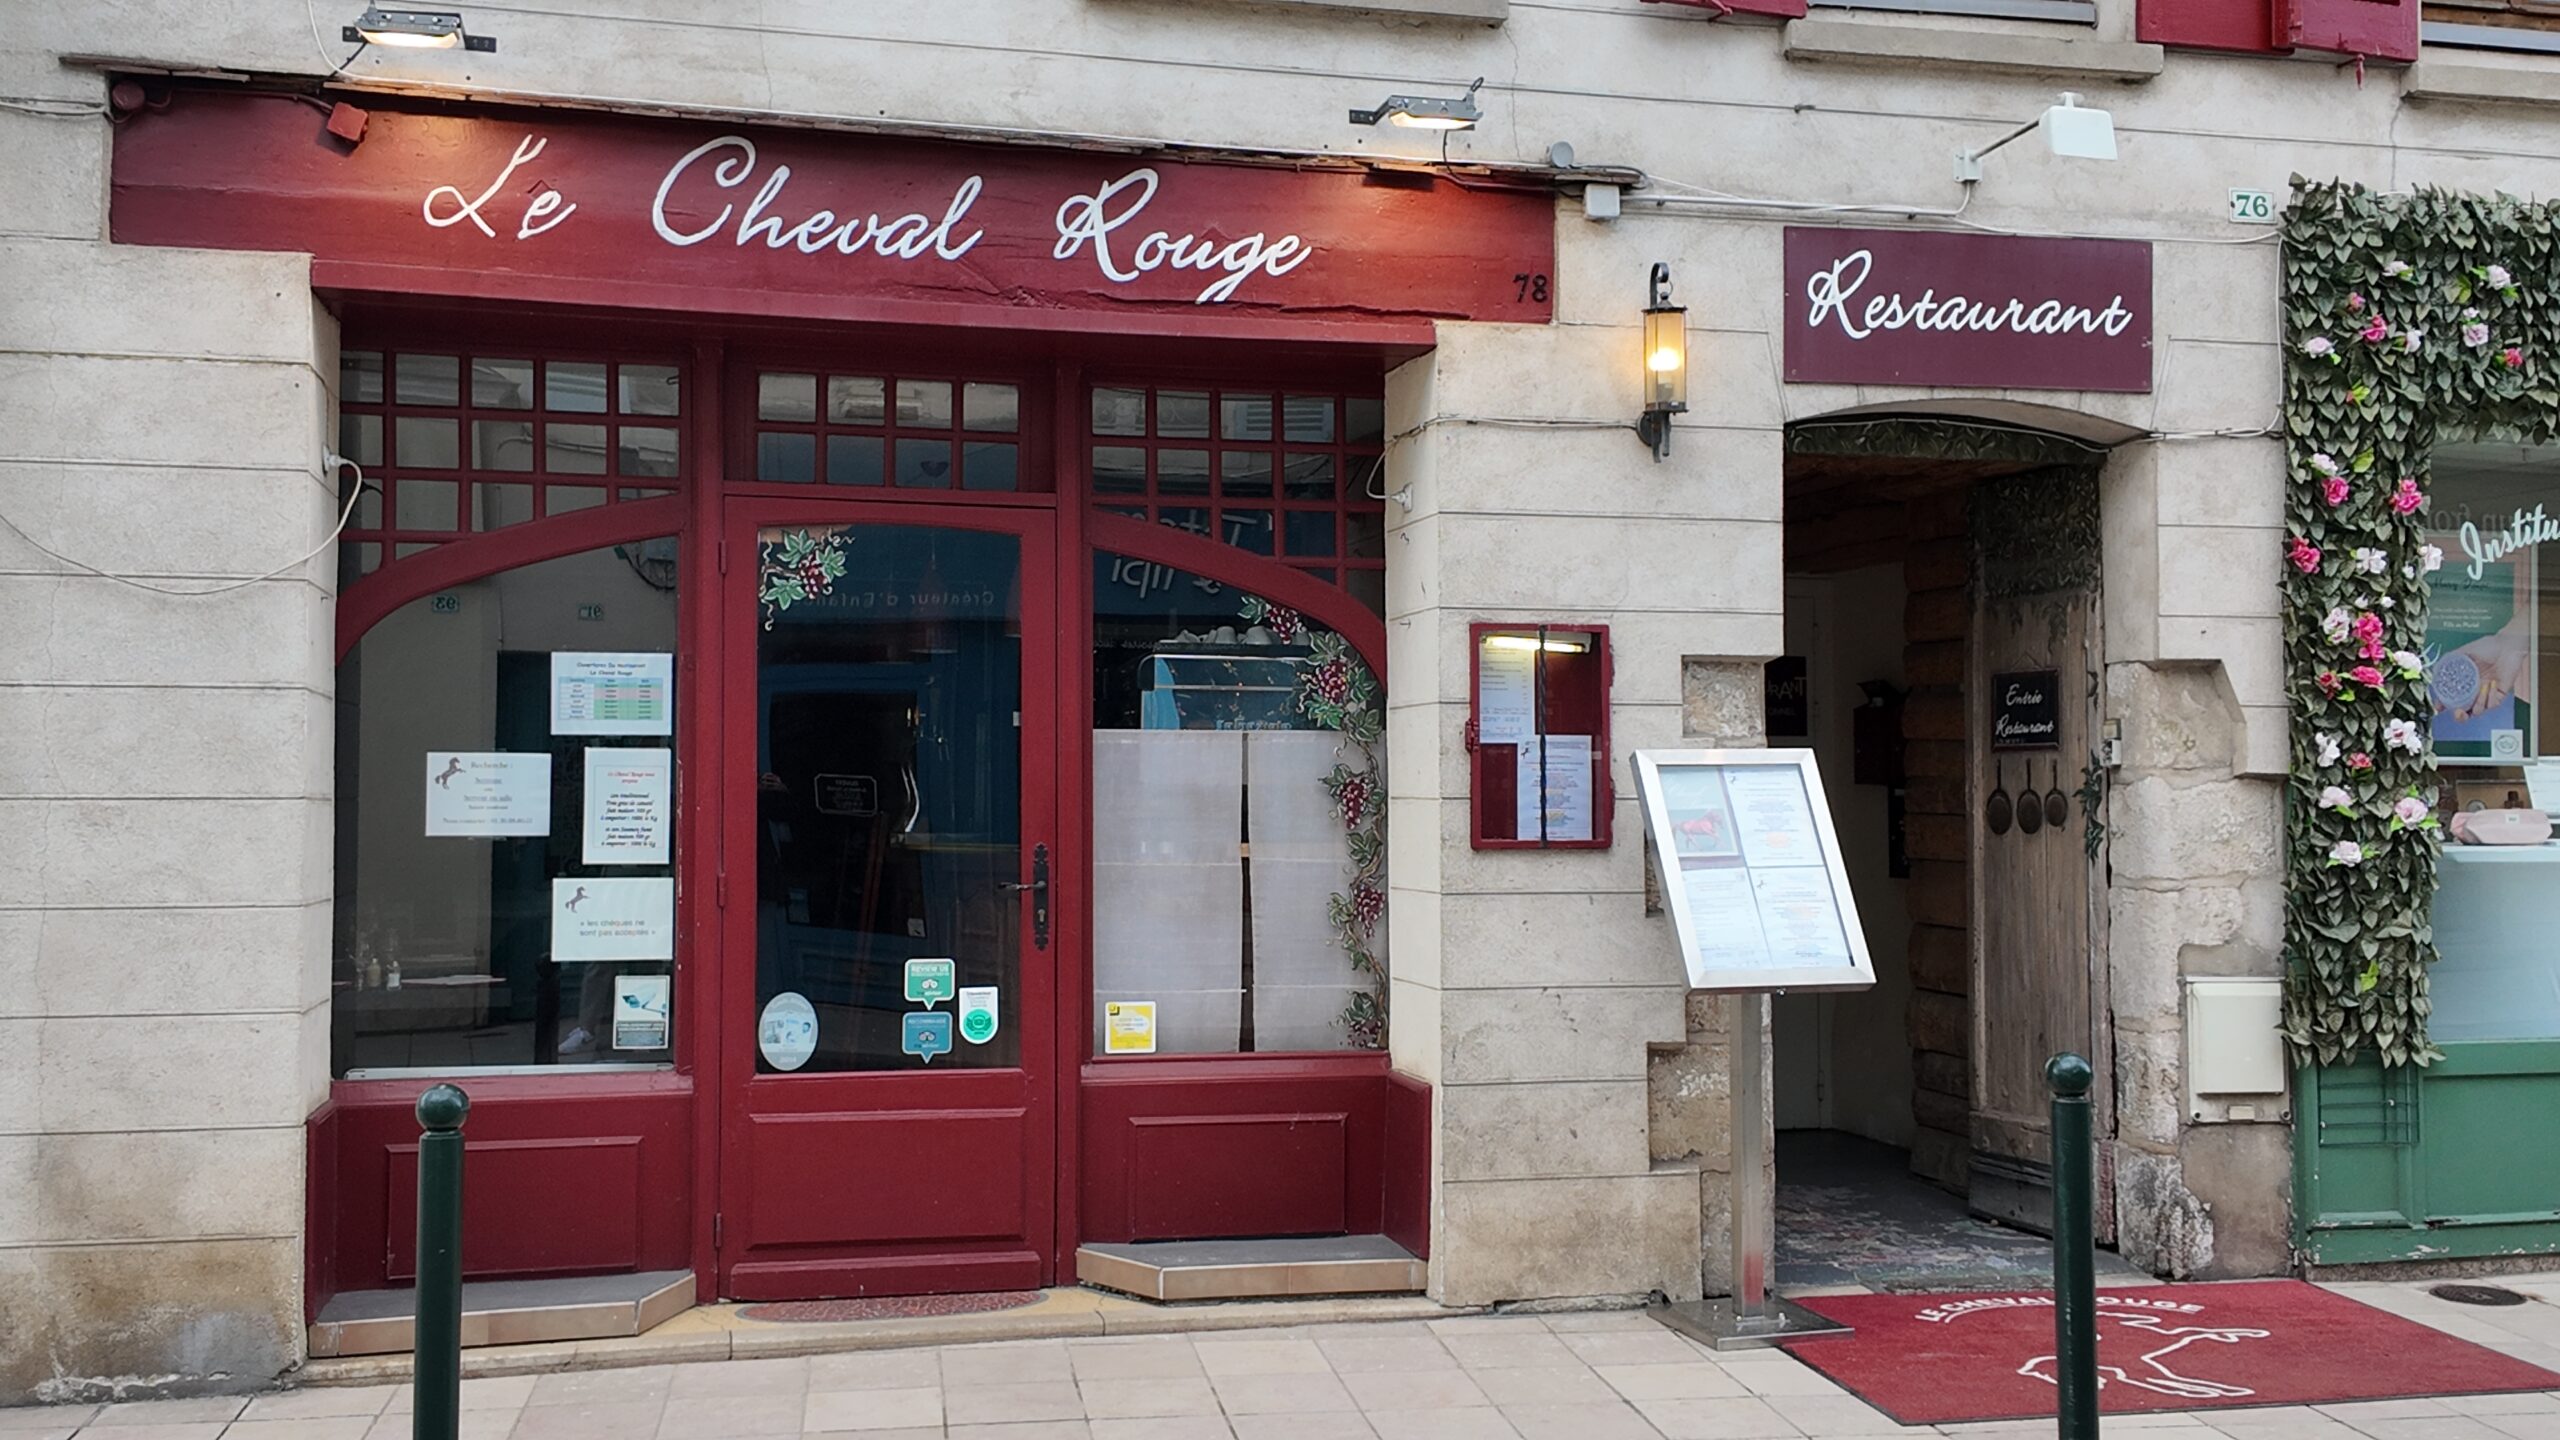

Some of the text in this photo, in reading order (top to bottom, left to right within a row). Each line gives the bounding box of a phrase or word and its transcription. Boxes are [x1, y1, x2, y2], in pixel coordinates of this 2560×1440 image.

[2236, 194, 2268, 217] 76
[422, 134, 1313, 304] Le Cheval Rouge
[1513, 273, 1549, 303] 78
[1807, 249, 2133, 340] Restaurant
[1995, 714, 2055, 737] Restaurant
[2096, 1296, 2205, 1314] OUGE
